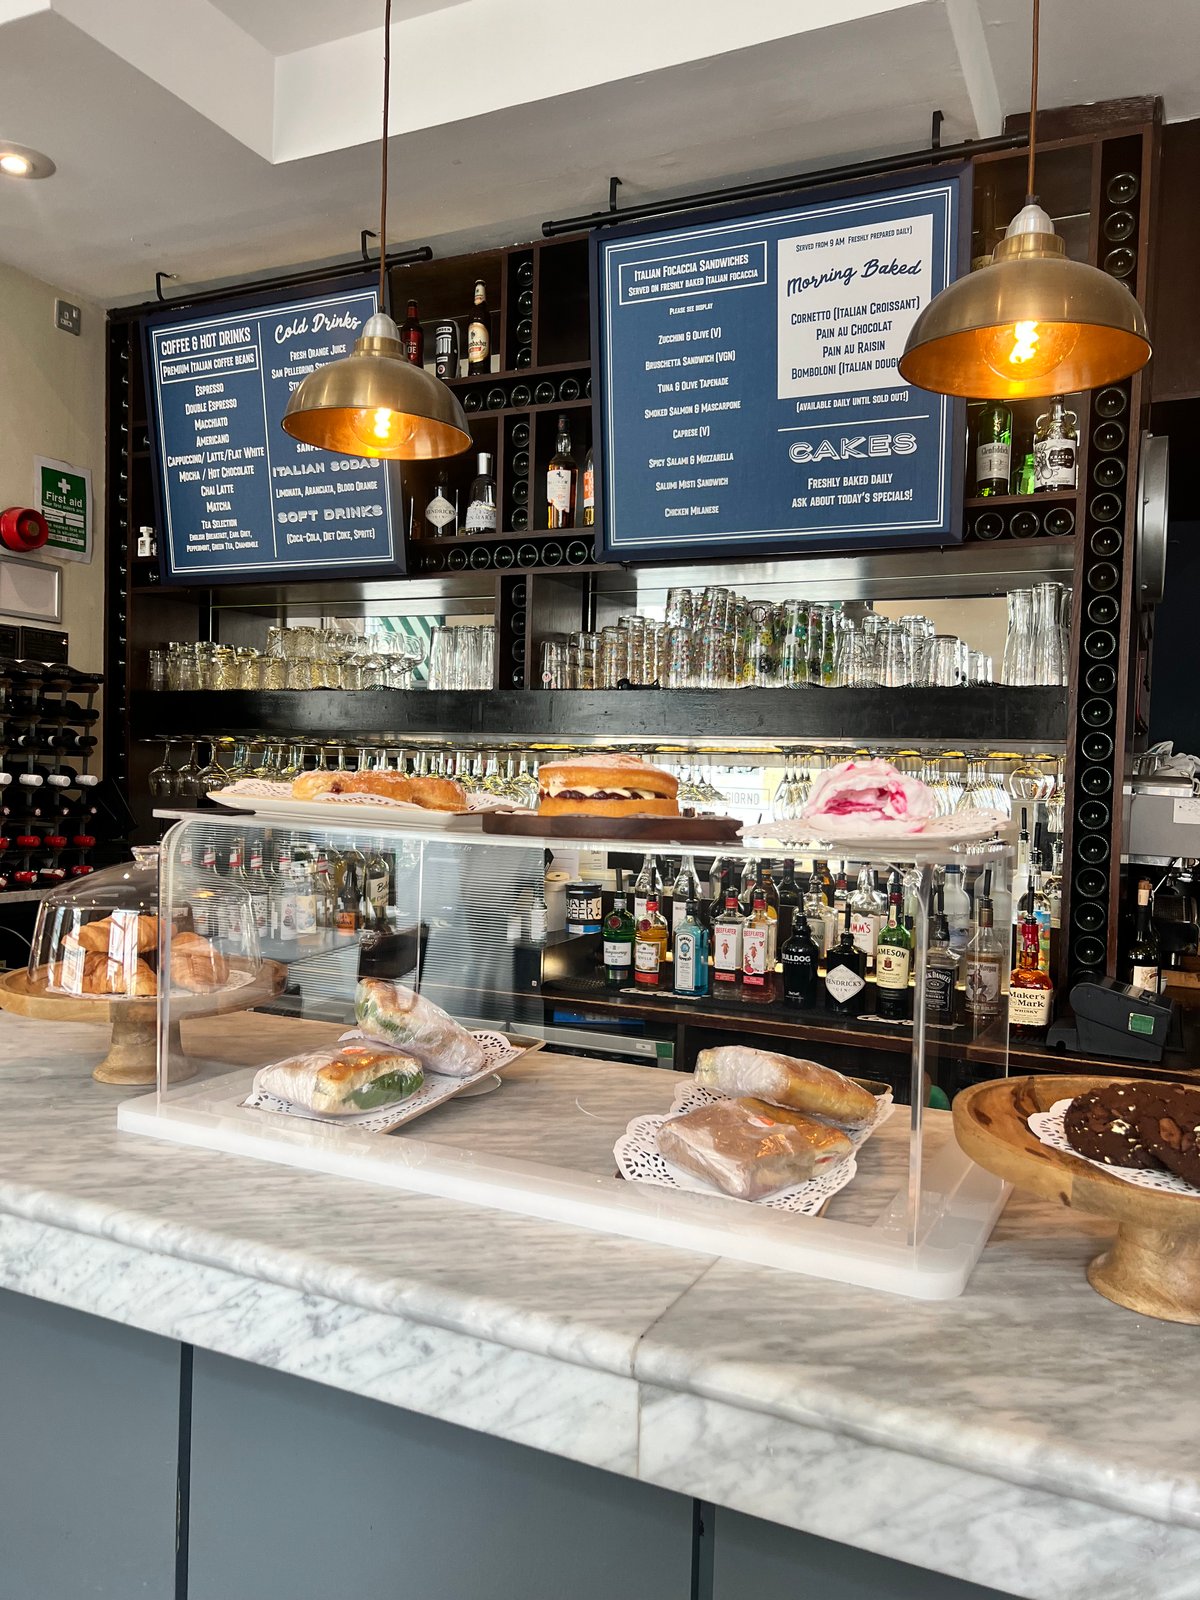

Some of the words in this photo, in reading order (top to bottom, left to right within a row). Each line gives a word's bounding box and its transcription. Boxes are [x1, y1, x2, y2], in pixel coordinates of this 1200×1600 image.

[830, 239, 834, 247] 9
[835, 237, 844, 245] AM
[787, 266, 857, 297] Morning
[861, 258, 922, 278] Baked
[275, 318, 308, 344] Cold
[311, 311, 361, 332] Drinks
[686, 332, 691, 341] &
[711, 327, 721, 338] (V)
[161, 338, 190, 355] COFFEE
[192, 336, 198, 350] &
[200, 333, 216, 349] HOT
[219, 327, 250, 345] DRINKS
[716, 350, 735, 363] (VGN)
[675, 382, 679, 391] &
[695, 404, 699, 413] &
[700, 426, 709, 437] (V)
[789, 433, 917, 463] CAKES
[273, 463, 325, 477] ITALIAN
[330, 458, 380, 471] SODAS
[690, 456, 695, 464] &
[843, 475, 868, 486] BAKED
[871, 473, 893, 484] DAILY
[47, 491, 66, 504] First
[69, 498, 82, 507] aid
[792, 498, 807, 508] ASK
[810, 496, 835, 506] ABOUT
[873, 489, 912, 502] SPECIALS!
[278, 510, 318, 523] SOFT
[324, 505, 383, 520] DRINKS
